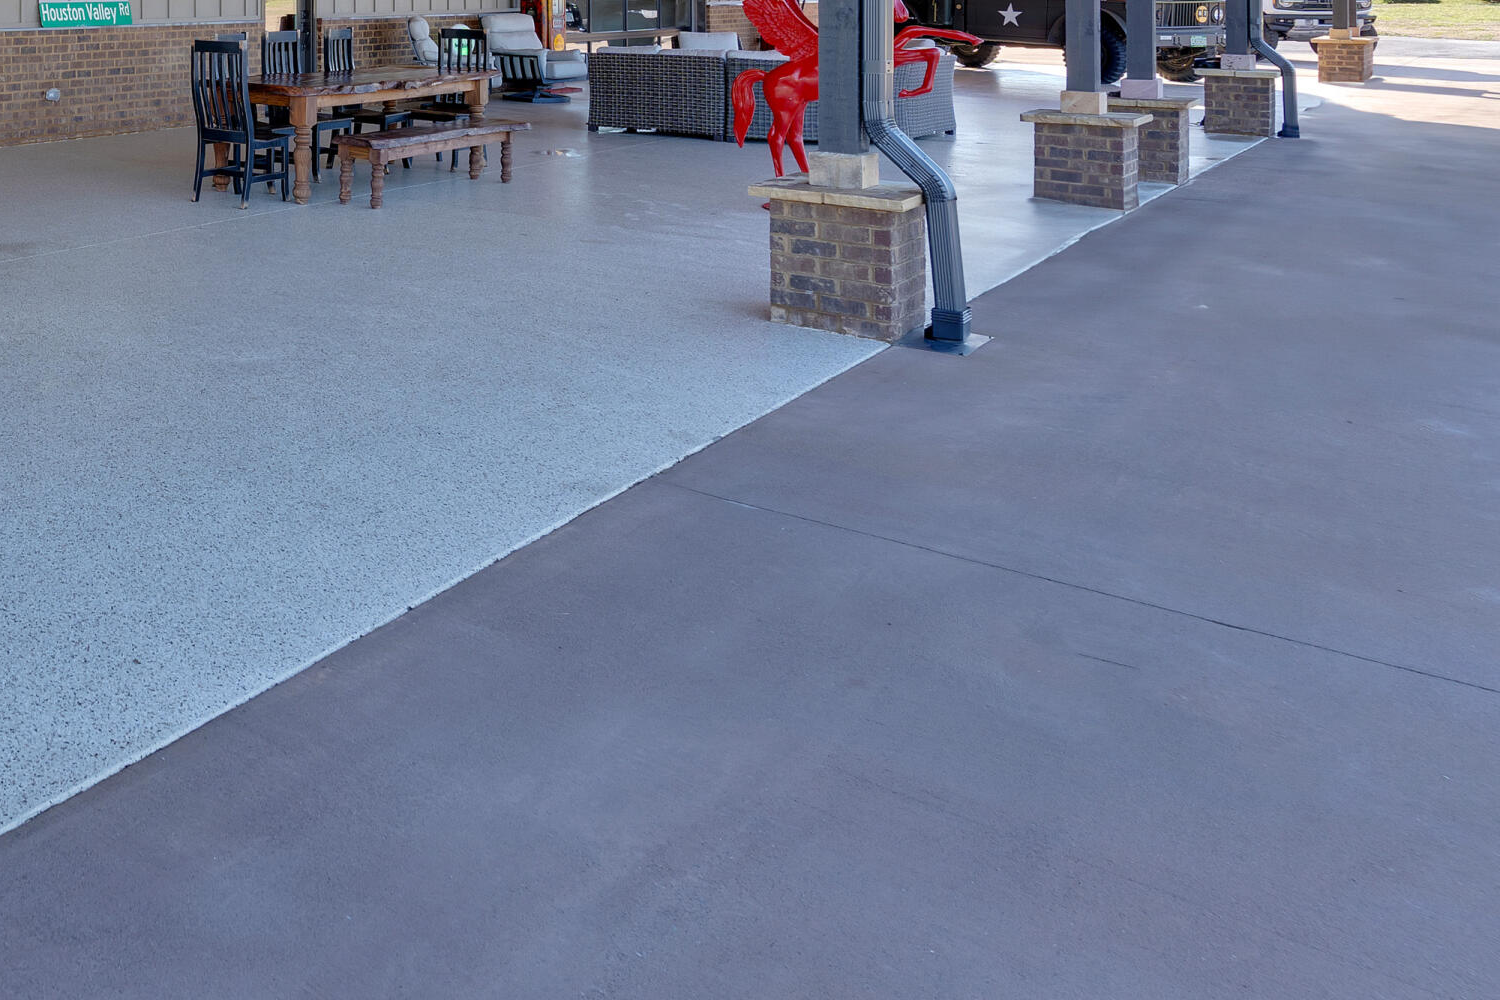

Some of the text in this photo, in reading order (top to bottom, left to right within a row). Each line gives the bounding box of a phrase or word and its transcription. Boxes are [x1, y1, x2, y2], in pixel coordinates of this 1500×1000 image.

[41, 2, 130, 24] Houston Valley Rd
